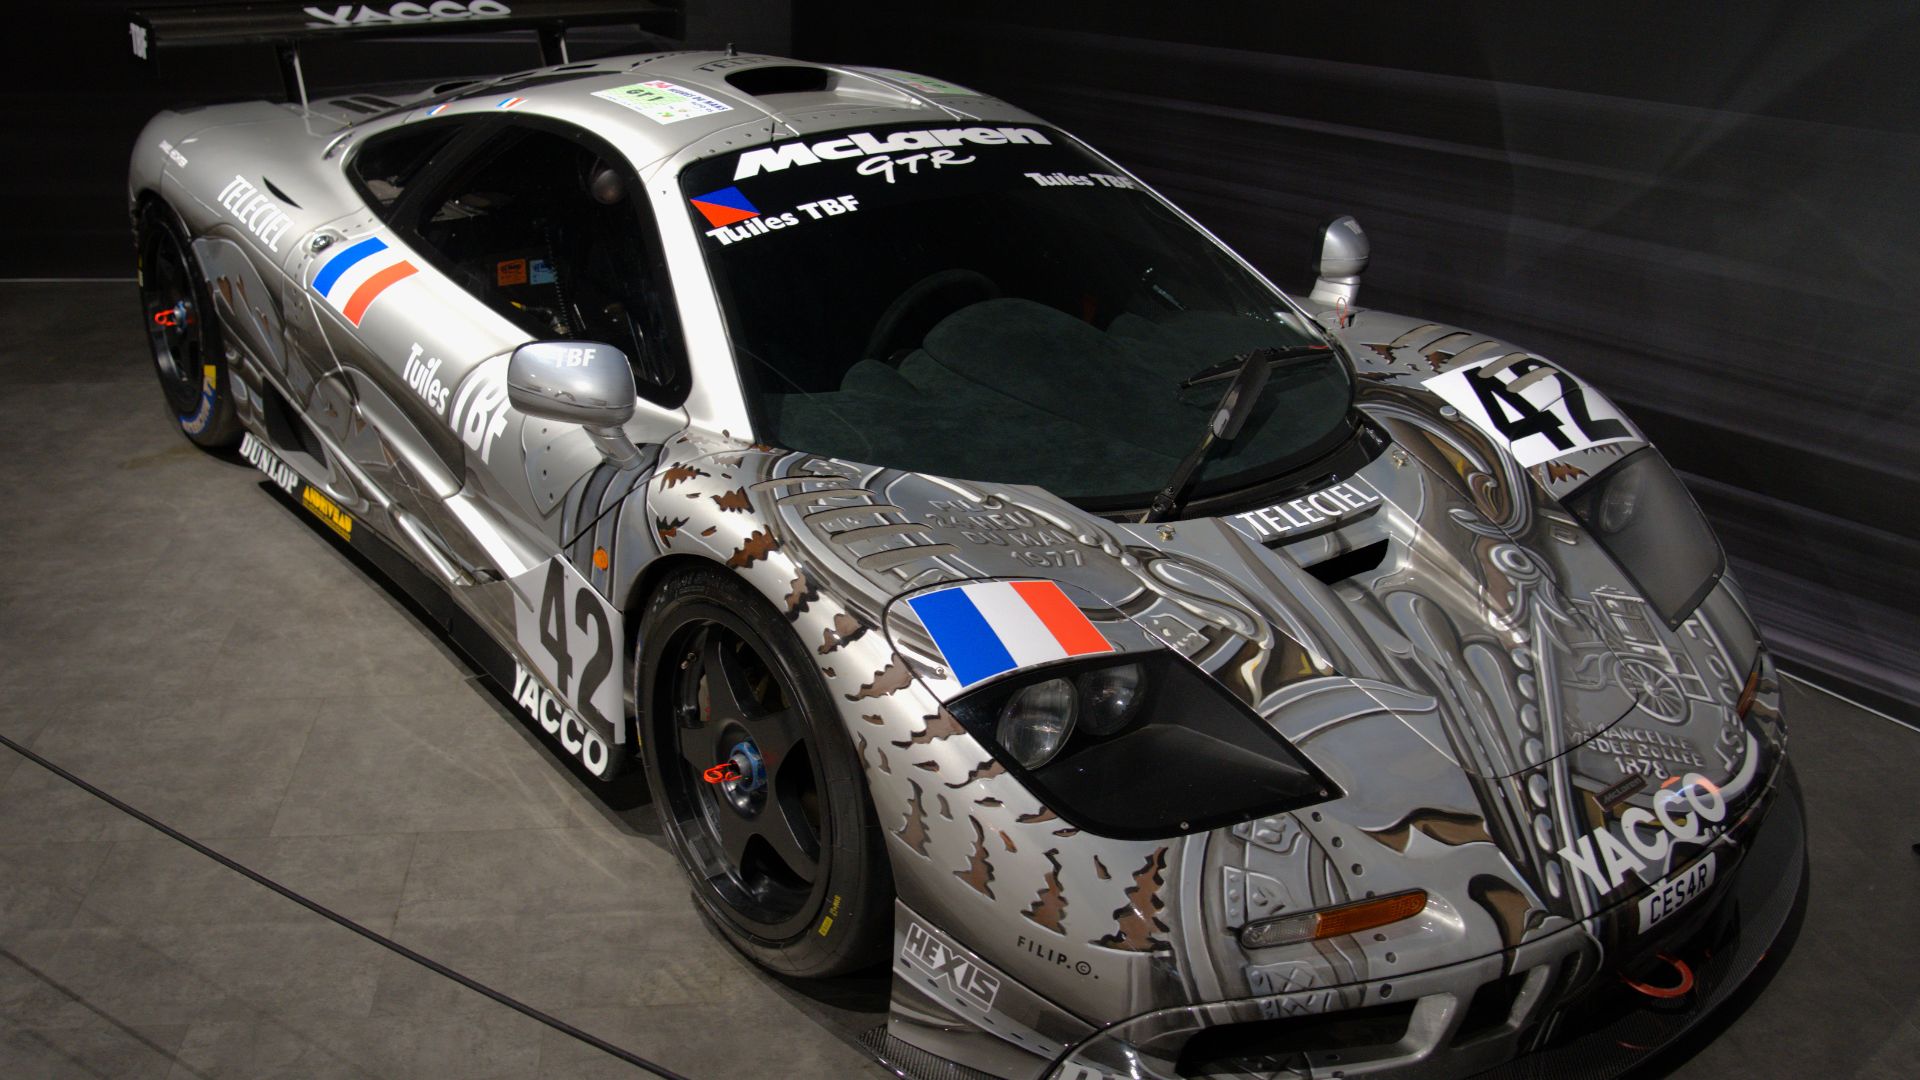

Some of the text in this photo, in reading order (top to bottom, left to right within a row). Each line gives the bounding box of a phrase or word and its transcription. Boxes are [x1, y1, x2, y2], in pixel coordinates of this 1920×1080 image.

[304, 0, 511, 26] YACCO
[733, 127, 1052, 181] McLaren
[856, 149, 976, 184] GTR
[1024, 173, 1136, 190] Tuiles TBF
[217, 175, 295, 253] TELECIEL
[705, 195, 860, 246] Tuiles TBF
[402, 342, 450, 416] Tuiles
[555, 348, 597, 368] TBF
[1463, 353, 1636, 451] 42
[239, 431, 299, 494] DUNLOP
[1235, 483, 1380, 537] TELECIEL
[1011, 549, 1085, 568] 1977
[540, 557, 616, 745] 42
[512, 662, 609, 776] YACCO
[1614, 757, 1669, 780] 1878
[1557, 773, 1726, 895] YACCO
[1650, 863, 1708, 925] CES4R
[906, 924, 999, 1004] HEXIS
